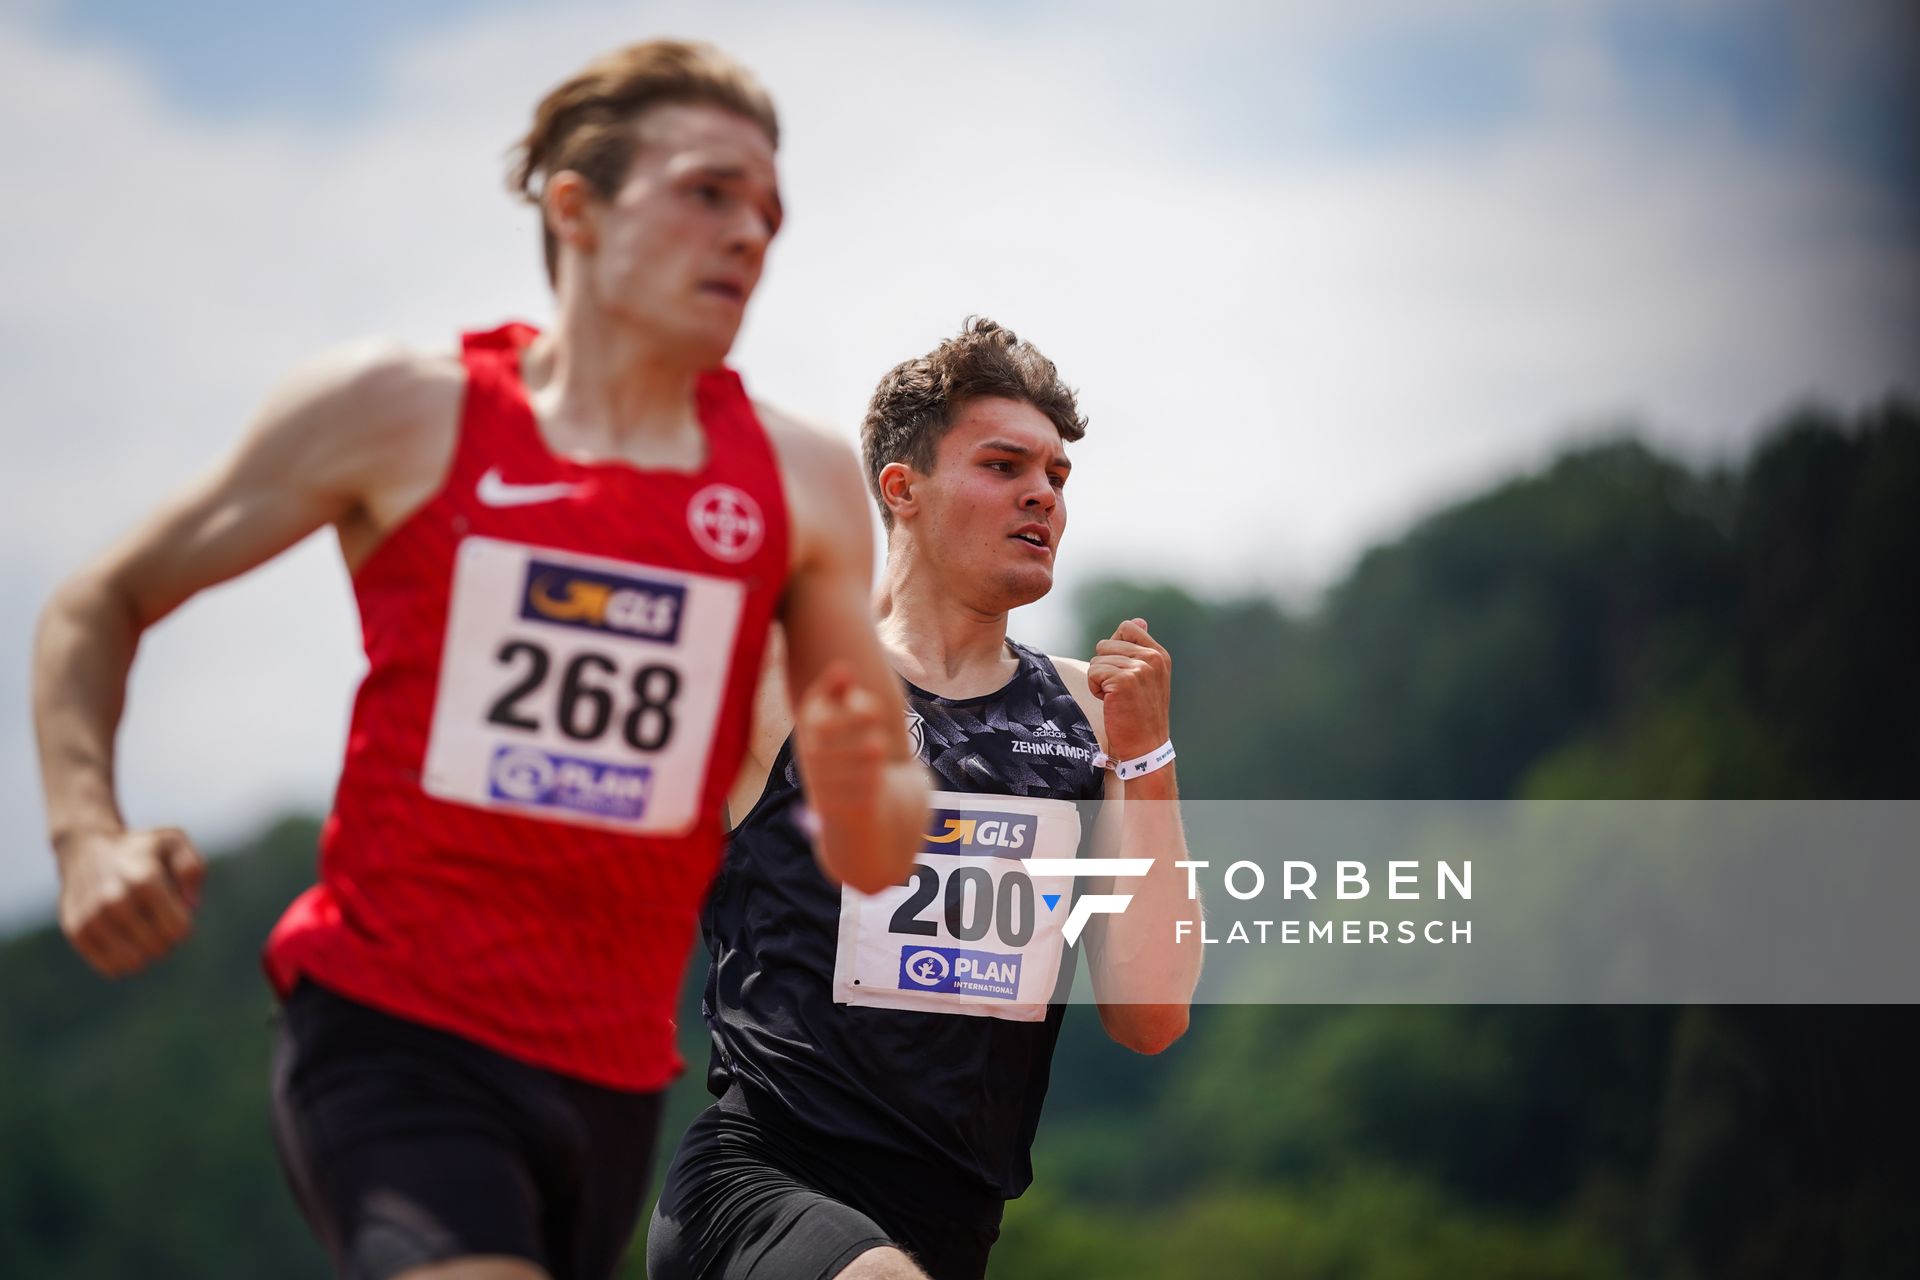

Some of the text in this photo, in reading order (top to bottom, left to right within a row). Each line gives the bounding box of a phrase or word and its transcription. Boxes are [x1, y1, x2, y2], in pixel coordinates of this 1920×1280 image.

[485, 639, 681, 753] 268
[1032, 729, 1067, 739] adidas
[1011, 740, 1091, 762] ZEHNKAMPF
[976, 820, 1027, 849] GLS
[888, 863, 1035, 947] 200
[954, 957, 1017, 984] PLAN
[953, 981, 1014, 995] INTERNATIONAL
